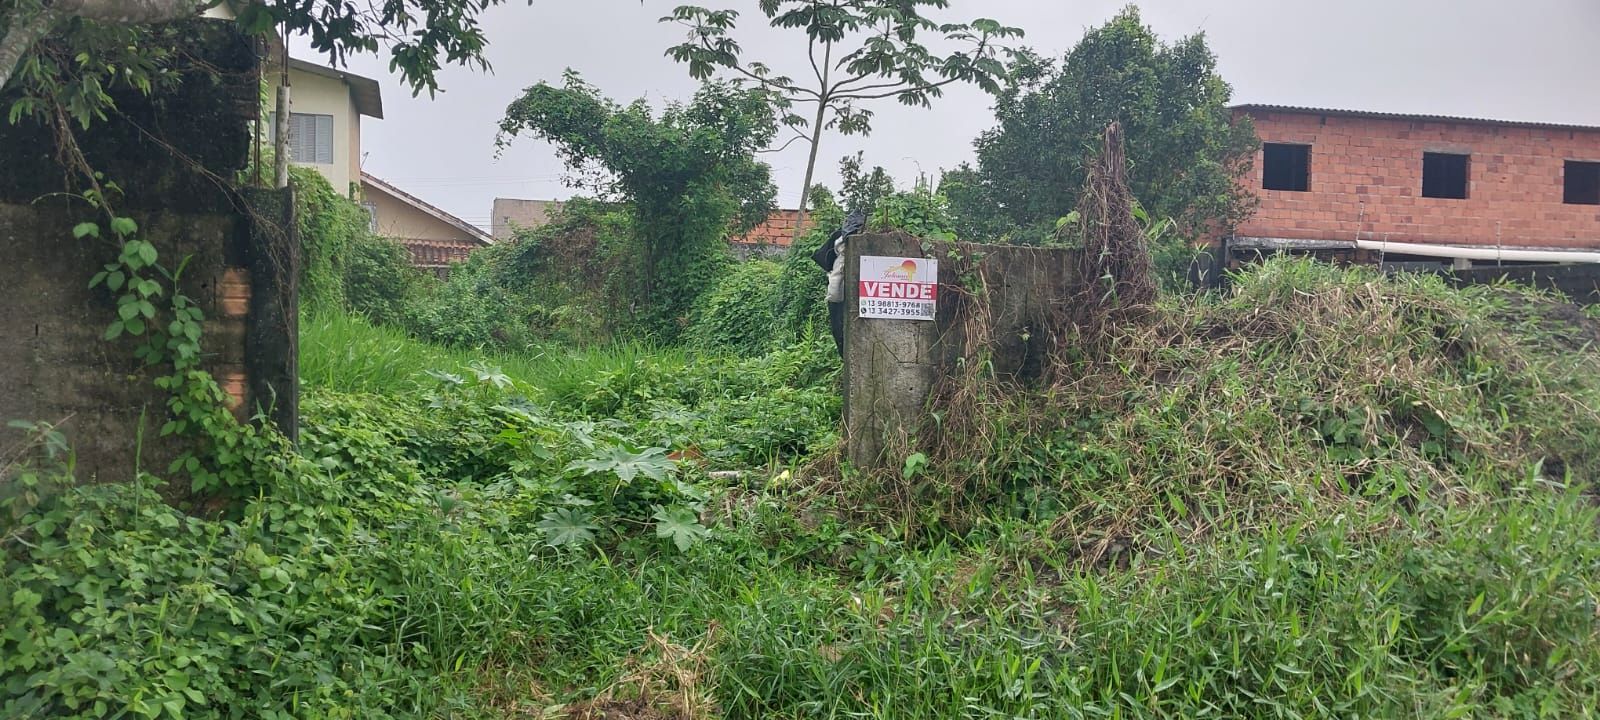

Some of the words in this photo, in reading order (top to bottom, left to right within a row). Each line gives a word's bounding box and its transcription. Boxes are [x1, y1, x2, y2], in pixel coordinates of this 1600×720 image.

[864, 282, 932, 299] VENDE
[868, 307, 875, 315] 13
[877, 307, 920, 316] 3427-3955
